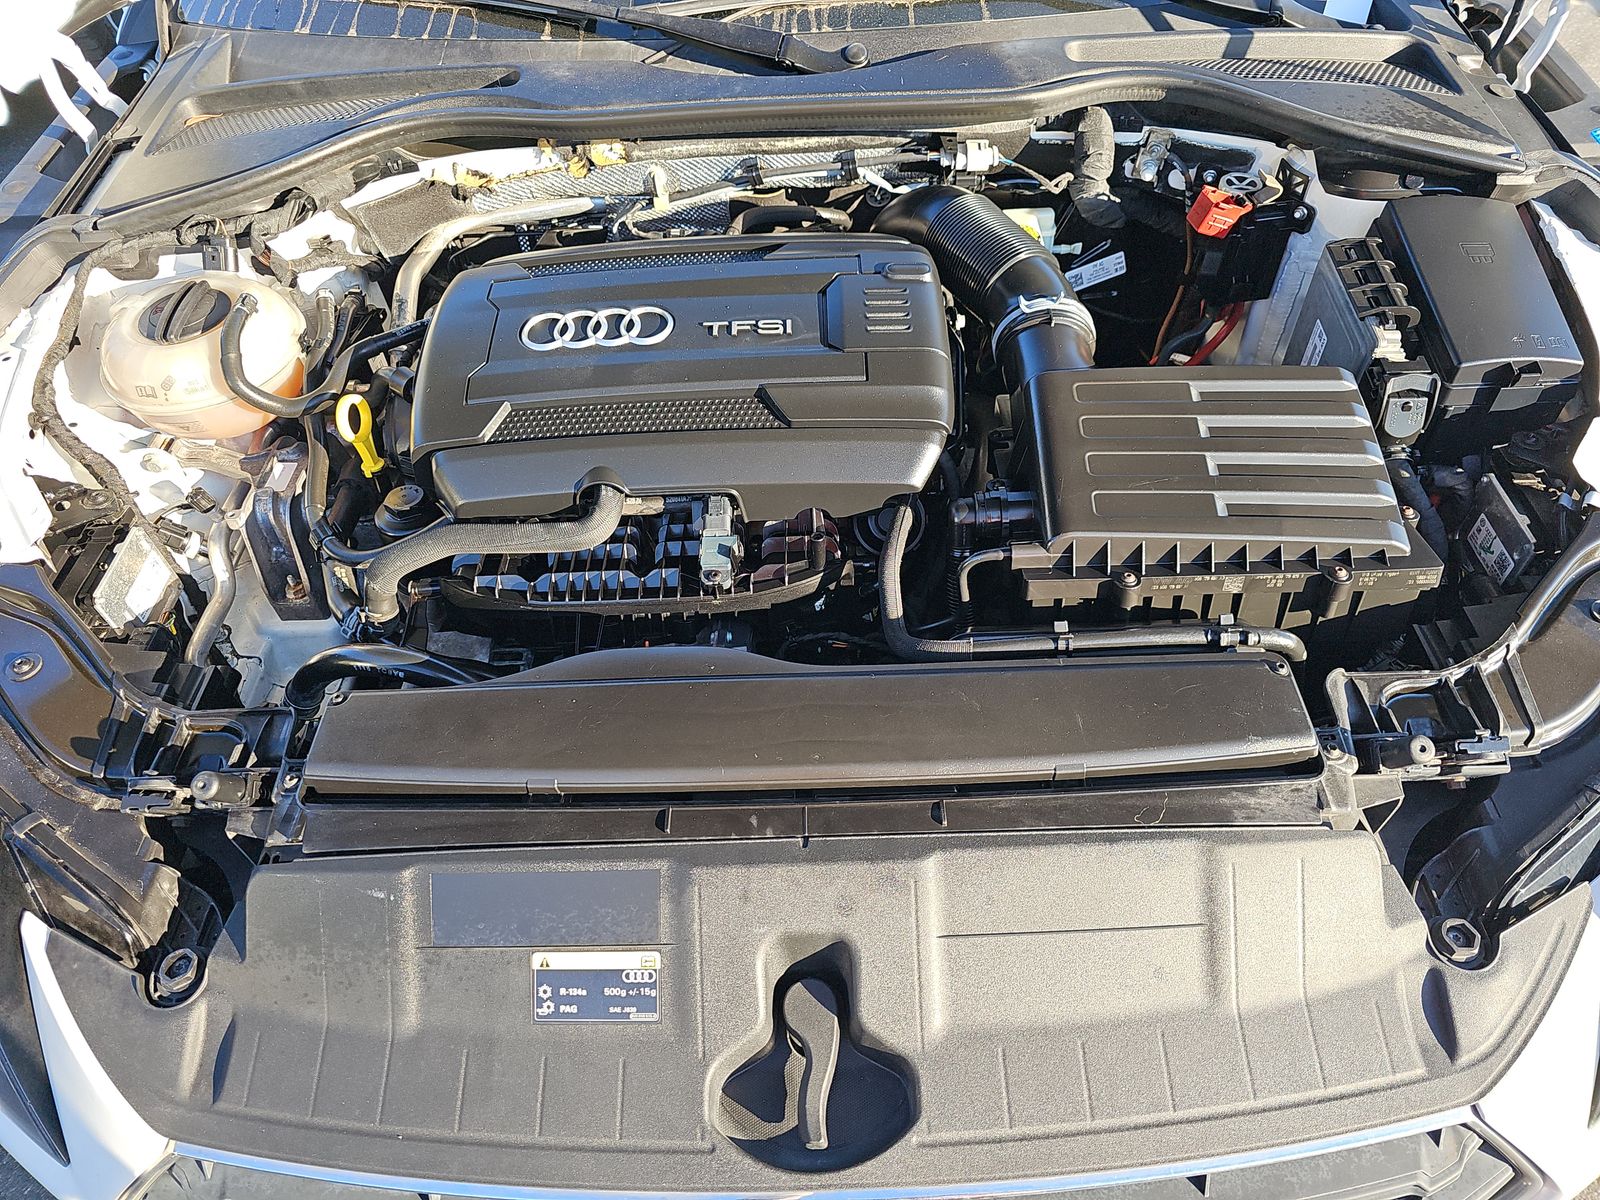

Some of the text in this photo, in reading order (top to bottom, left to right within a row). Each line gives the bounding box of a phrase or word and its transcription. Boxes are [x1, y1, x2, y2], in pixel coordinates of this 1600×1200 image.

[701, 319, 793, 337] TFSI
[559, 987, 587, 996] R-134a
[603, 987, 627, 997] 500g
[559, 1004, 578, 1013] PAG
